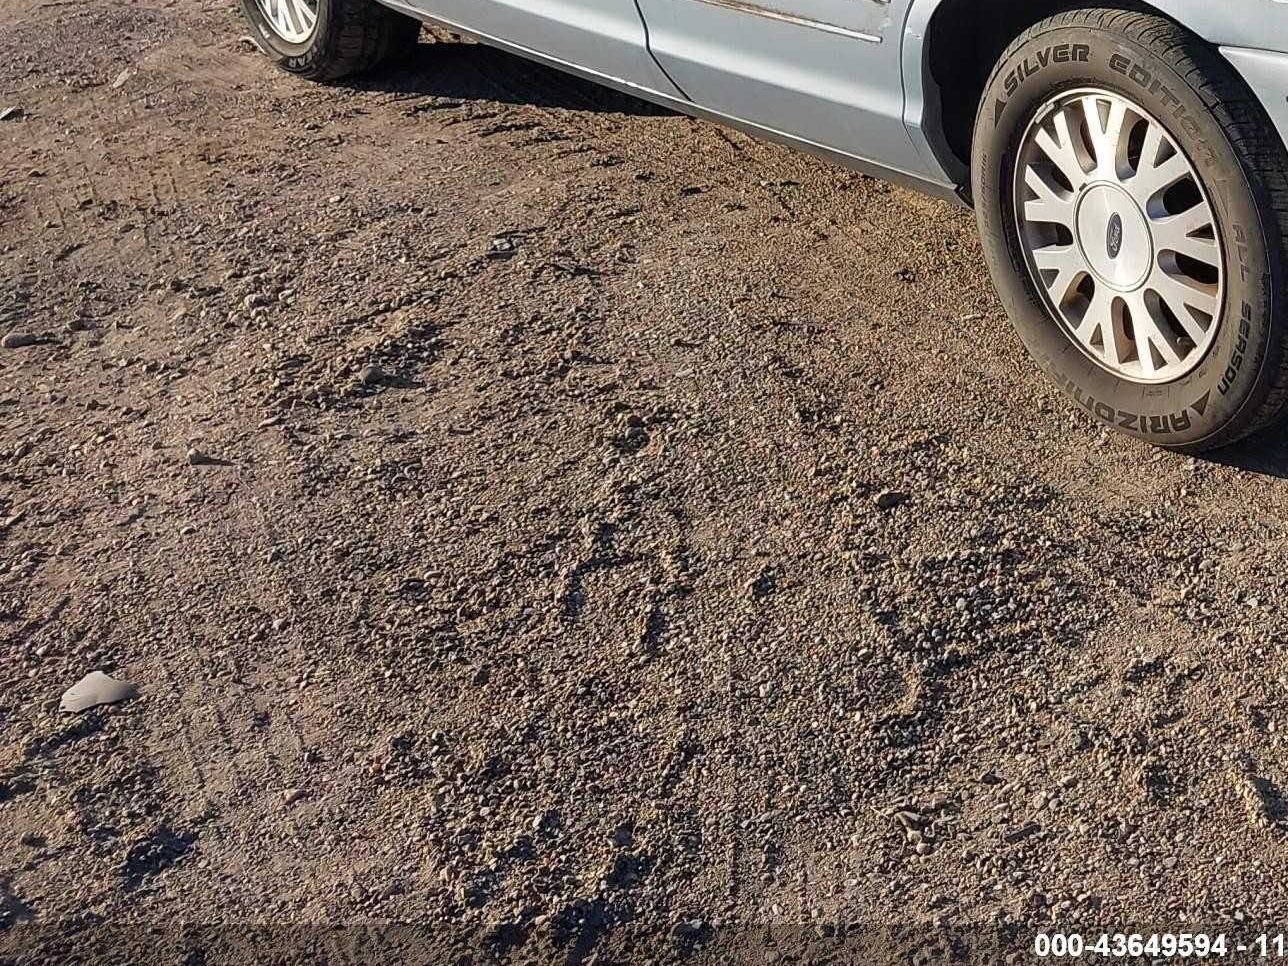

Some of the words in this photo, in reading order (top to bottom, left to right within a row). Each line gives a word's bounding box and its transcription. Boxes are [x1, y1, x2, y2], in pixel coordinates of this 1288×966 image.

[1003, 43, 1090, 98] SILVER
[1108, 52, 1223, 166] EDITION
[1232, 223, 1251, 282] ALL
[1217, 299, 1252, 396] SEASON
